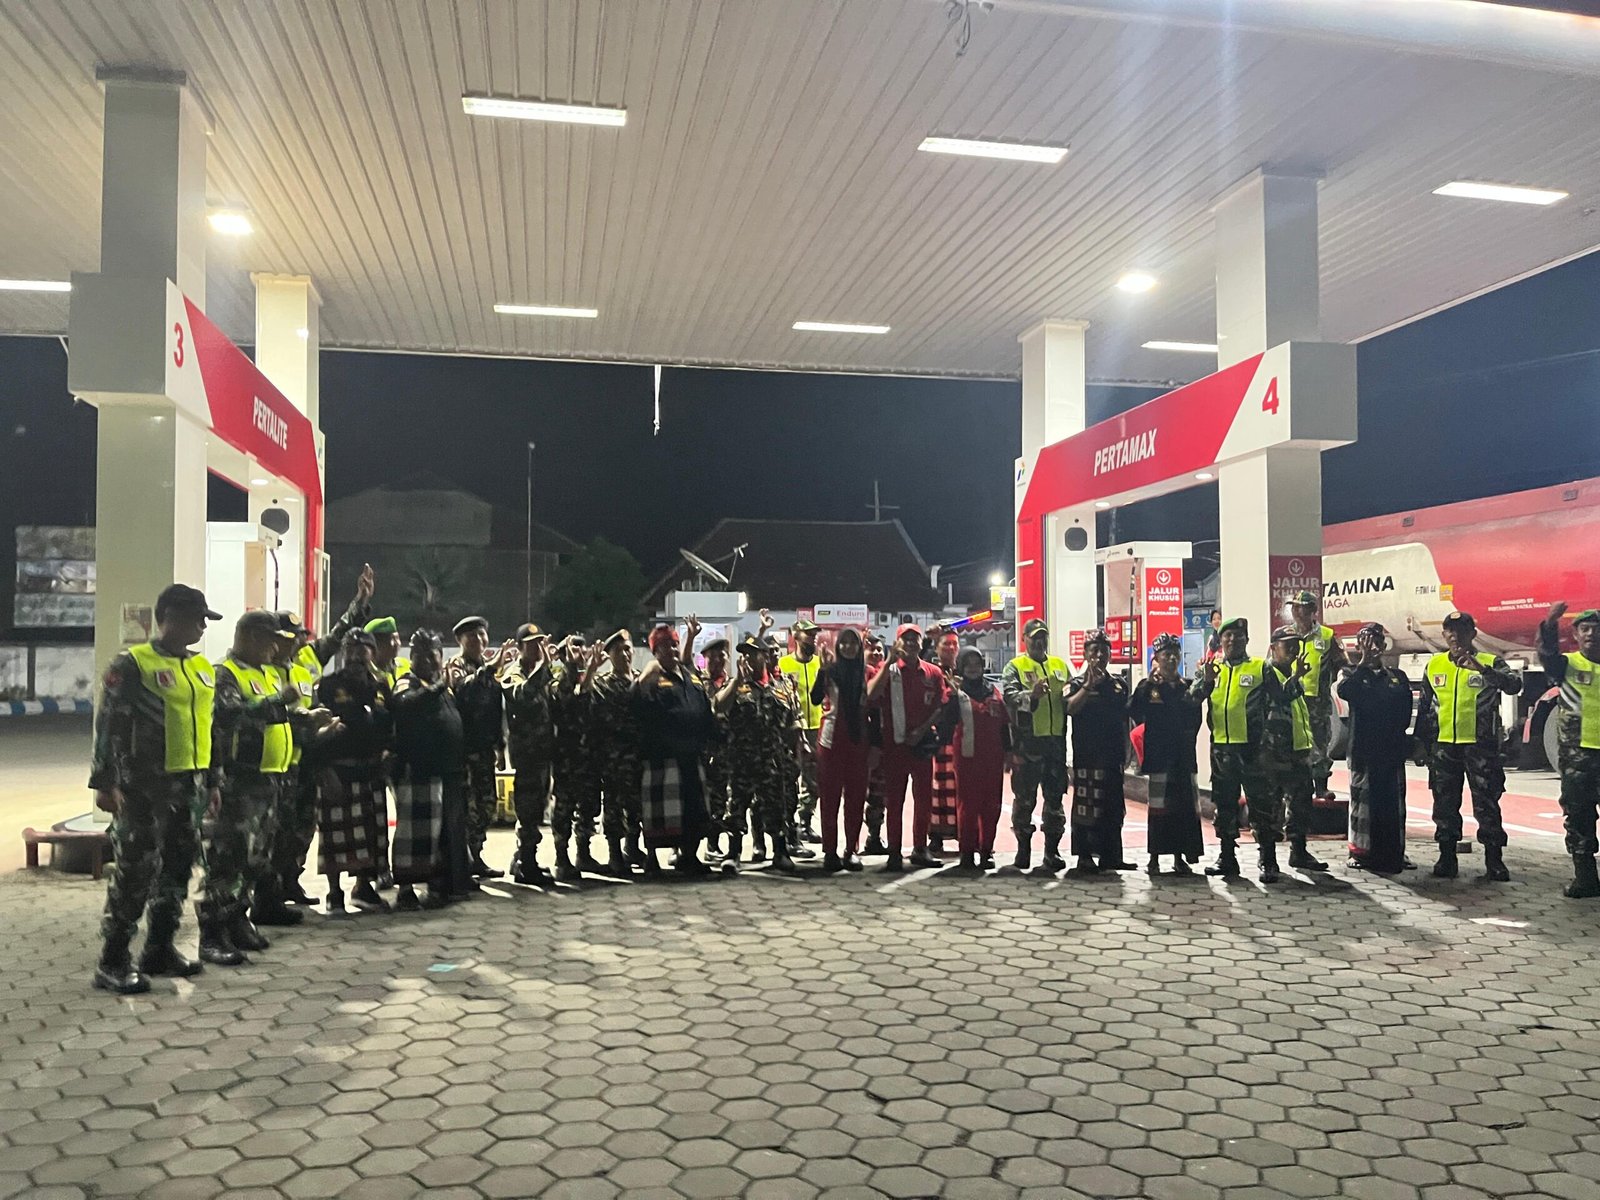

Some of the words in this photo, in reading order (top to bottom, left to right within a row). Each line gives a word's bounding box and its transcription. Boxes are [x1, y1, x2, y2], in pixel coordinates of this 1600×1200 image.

[173, 322, 184, 368] 3
[1262, 376, 1279, 415] 4
[253, 395, 288, 450] PERTALITE
[1093, 428, 1157, 476] PERTAMAX
[1148, 587, 1180, 595] JALUR
[1273, 577, 1320, 588] JALUR
[1322, 576, 1395, 598] TAMINA
[1324, 599, 1350, 609] IAGA
